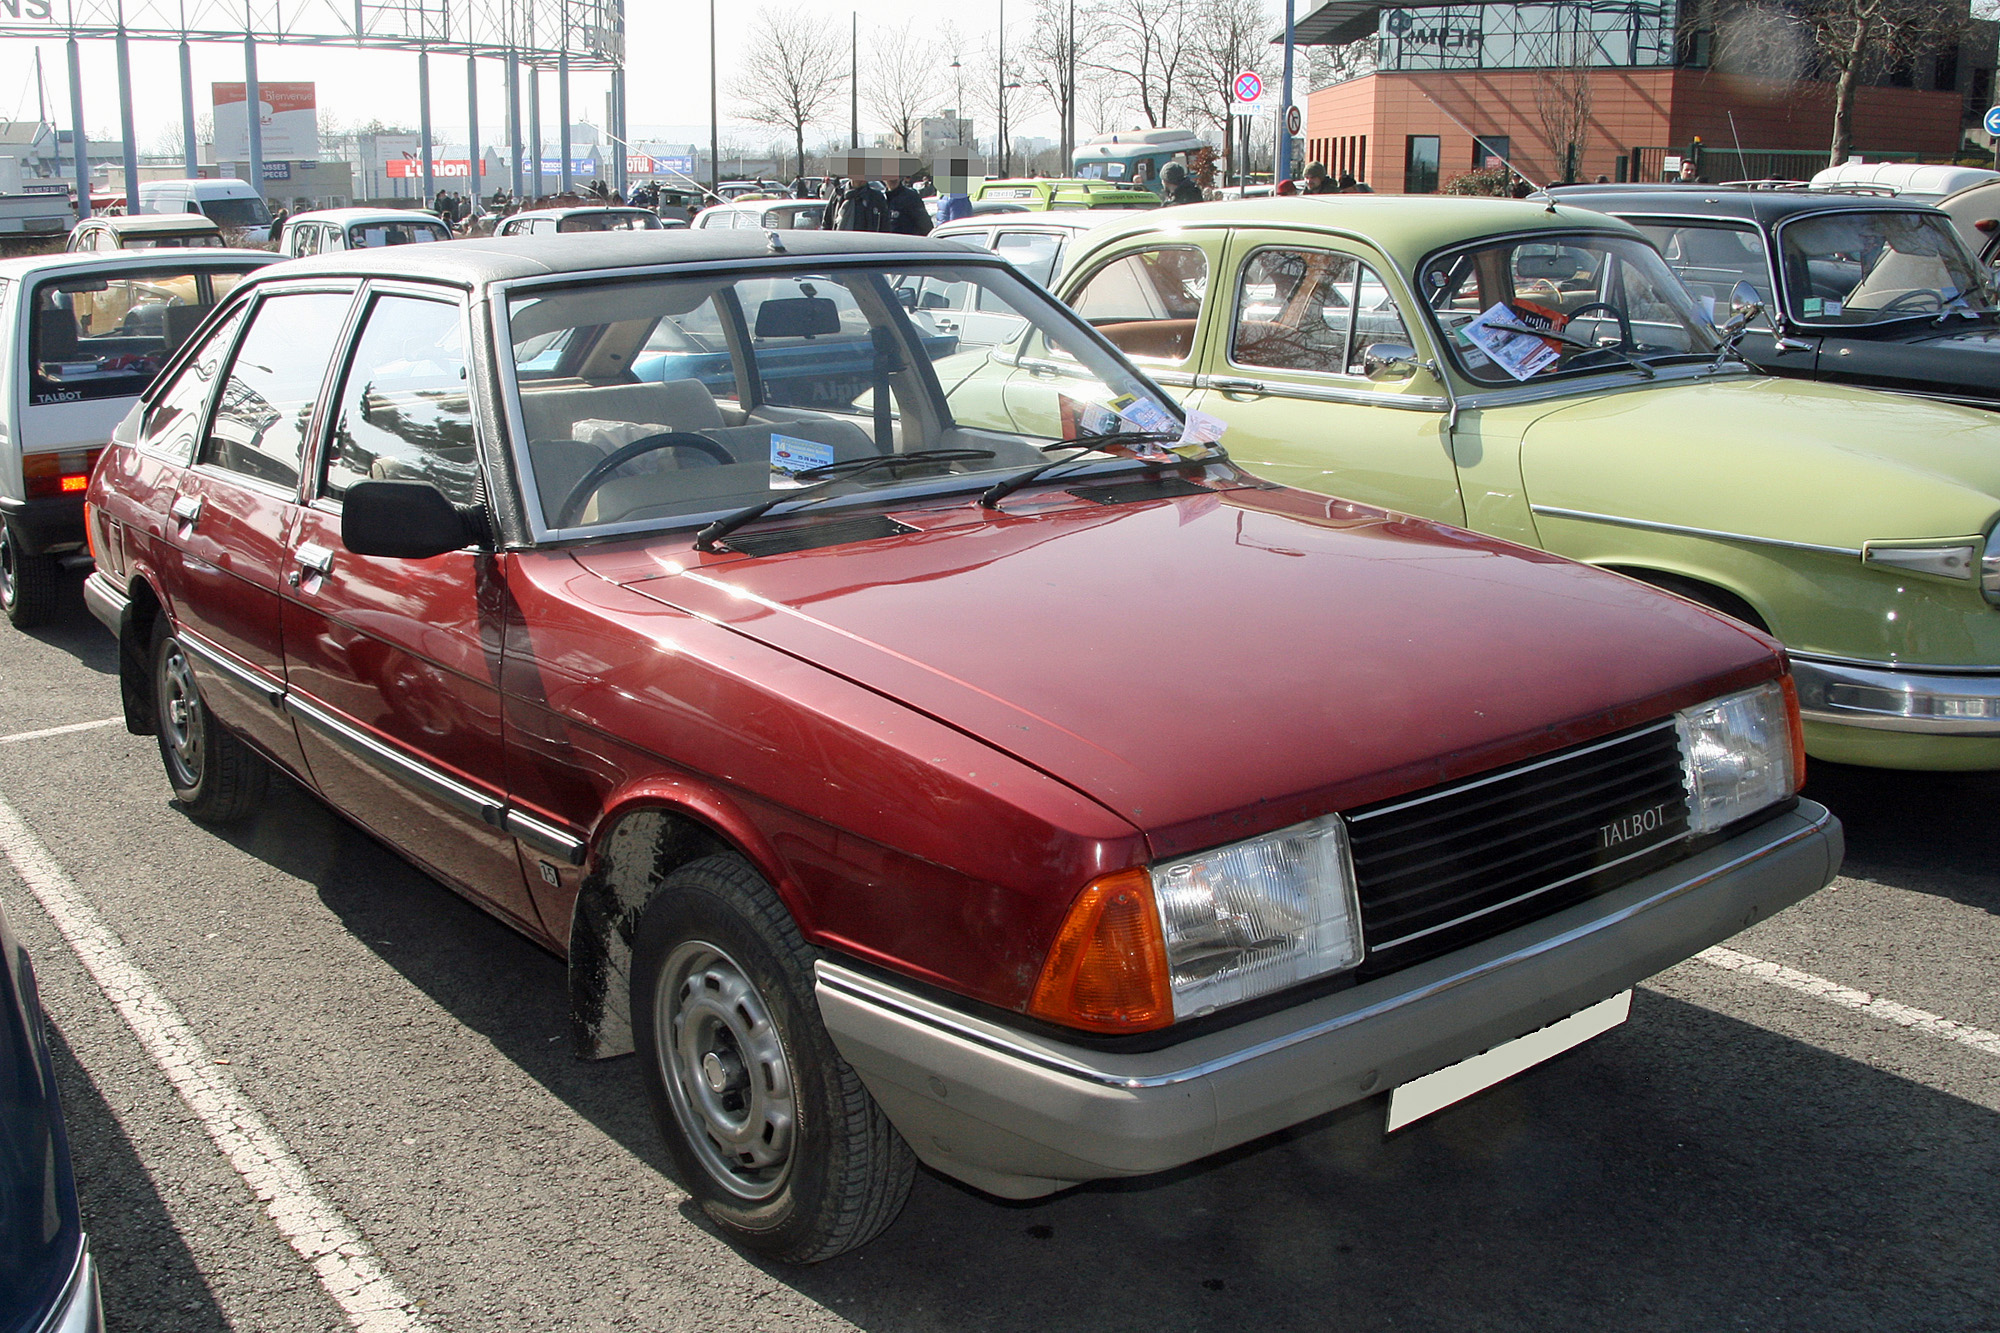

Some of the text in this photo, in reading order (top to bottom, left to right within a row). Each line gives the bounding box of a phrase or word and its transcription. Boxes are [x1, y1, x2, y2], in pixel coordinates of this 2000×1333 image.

[265, 90, 312, 101] Bienvenue
[626, 157, 650, 173] OTUL
[37, 391, 82, 403] TALBOT
[1600, 803, 1665, 848] TALBOT
